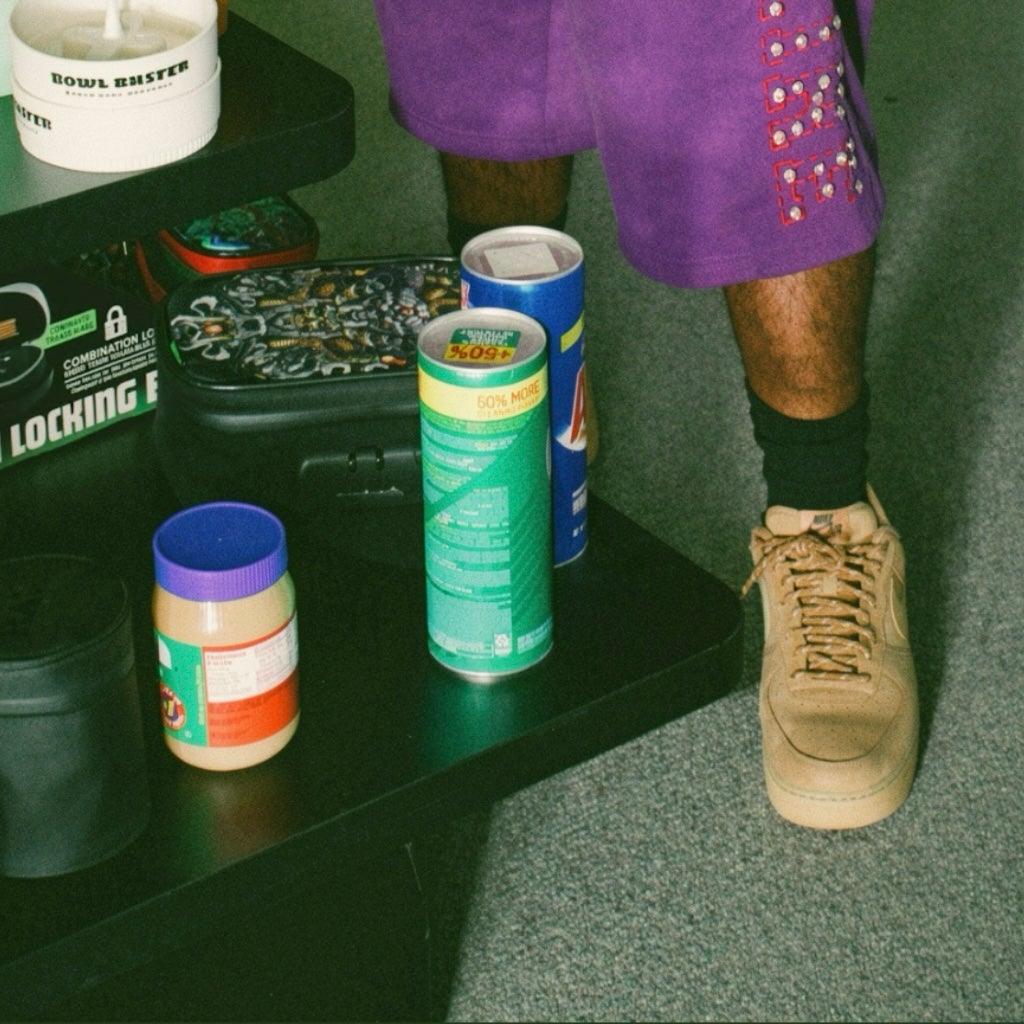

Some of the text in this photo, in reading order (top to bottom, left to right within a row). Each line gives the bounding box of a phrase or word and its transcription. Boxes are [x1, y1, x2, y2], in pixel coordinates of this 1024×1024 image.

[51, 60, 189, 89] BOWL BUSTER
[63, 334, 138, 370] COMBINATION
[511, 379, 541, 403] MORE
[10, 378, 137, 458] LOCKING
